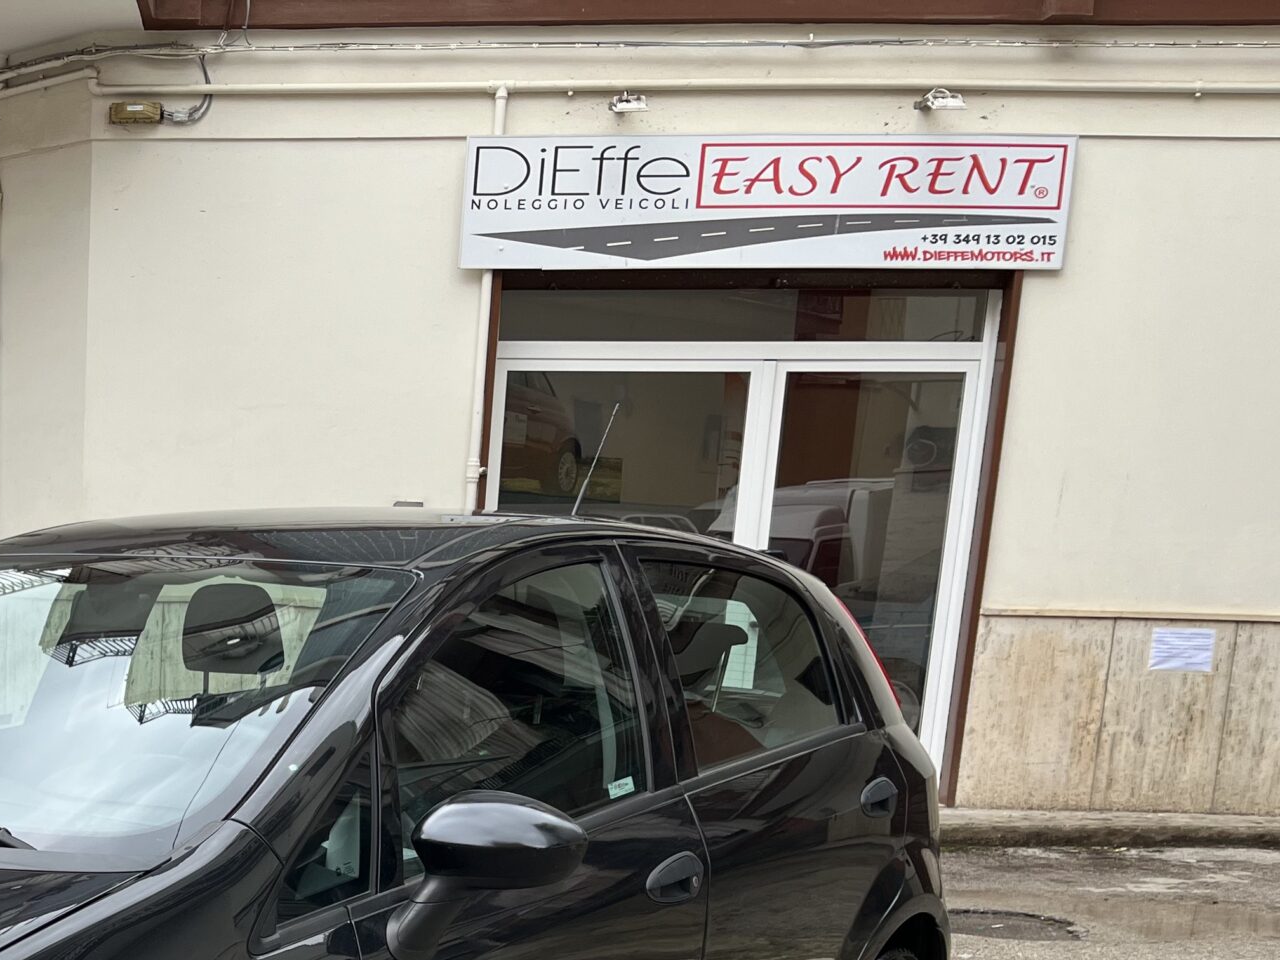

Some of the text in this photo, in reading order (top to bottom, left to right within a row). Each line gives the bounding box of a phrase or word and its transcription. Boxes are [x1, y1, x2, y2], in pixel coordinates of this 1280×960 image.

[473, 145, 690, 196] DiEffe
[711, 154, 1055, 197] EASY RENT
[471, 198, 689, 210] NOLEGGIO VEICOLI
[921, 233, 1057, 246] +39 349 13 02 015
